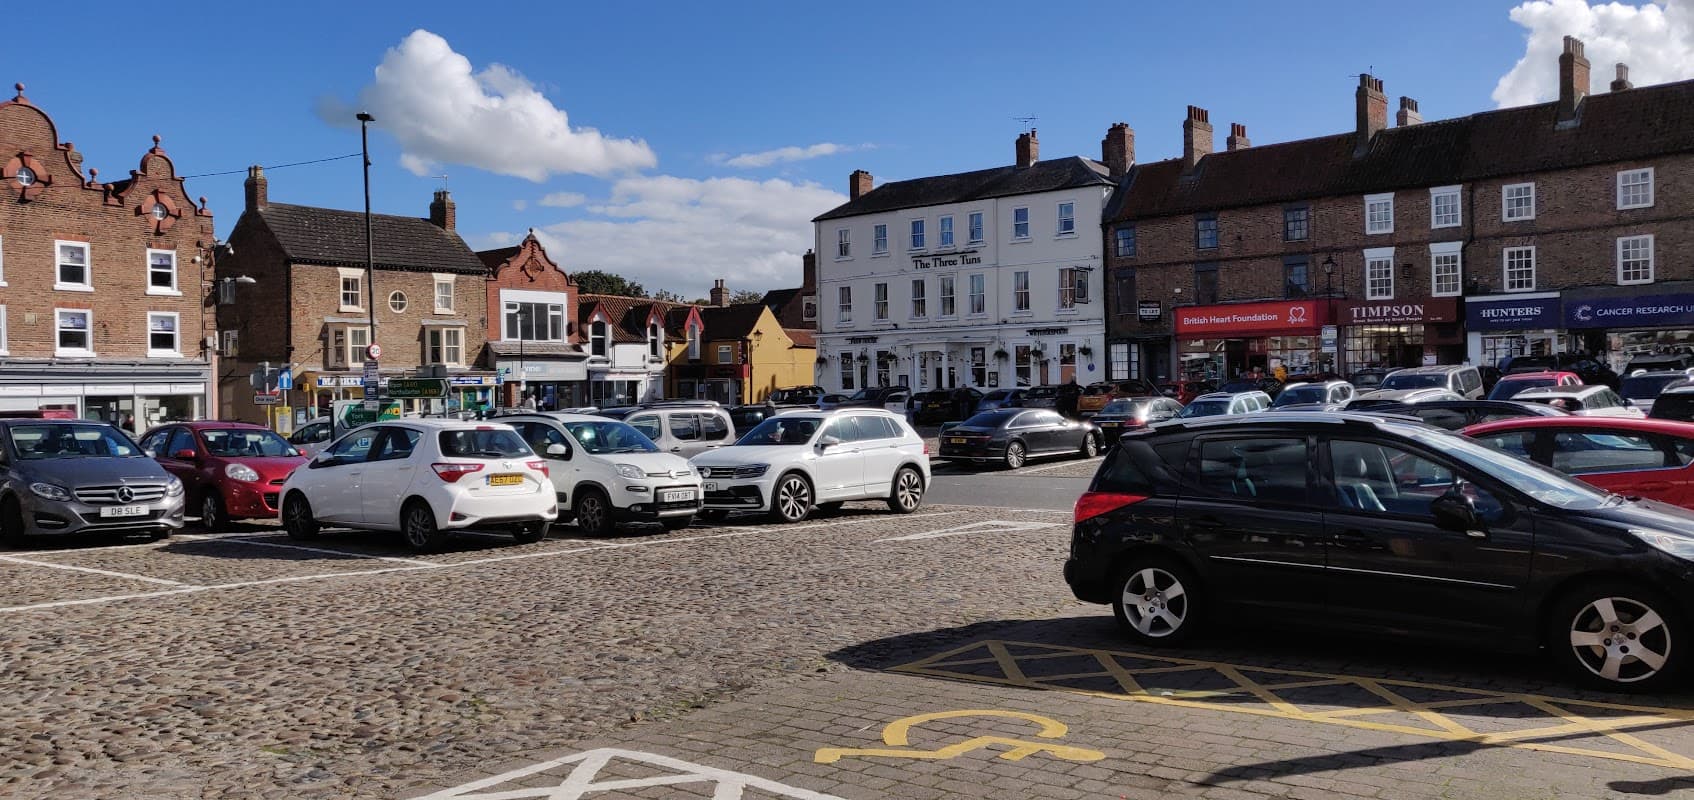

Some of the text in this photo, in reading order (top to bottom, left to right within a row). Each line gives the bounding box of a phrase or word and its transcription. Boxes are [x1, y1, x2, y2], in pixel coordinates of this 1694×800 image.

[913, 255, 981, 269] The Three Tuns
[1350, 305, 1424, 318] TIMPSON
[1480, 307, 1541, 317] HUNTERS
[1597, 308, 1632, 316] CANCER
[1636, 306, 1684, 315] RESEARCH
[1184, 313, 1278, 325] British Heart Foundation
